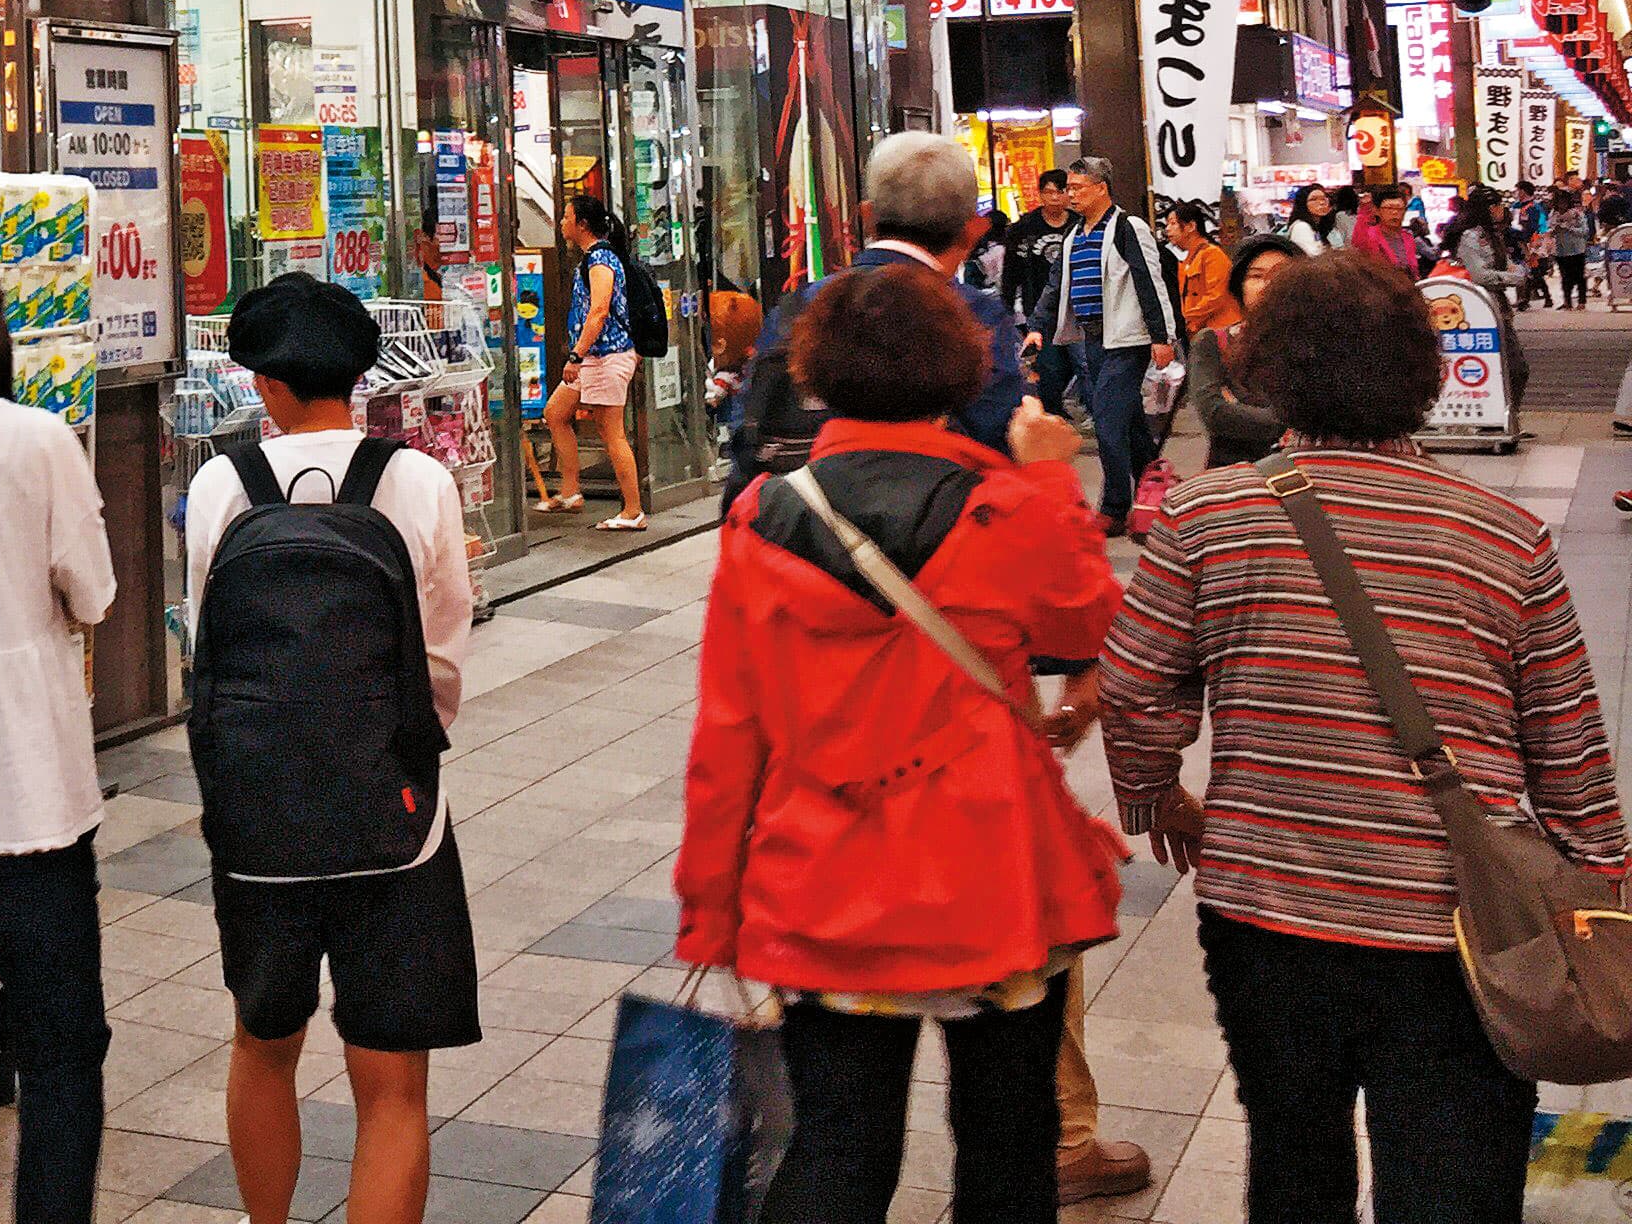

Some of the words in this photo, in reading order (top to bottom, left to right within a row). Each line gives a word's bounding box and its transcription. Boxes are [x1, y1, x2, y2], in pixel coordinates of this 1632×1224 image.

[94, 105, 123, 123] OPEN
[92, 132, 131, 156] 10:00
[90, 170, 130, 187] CLOSED
